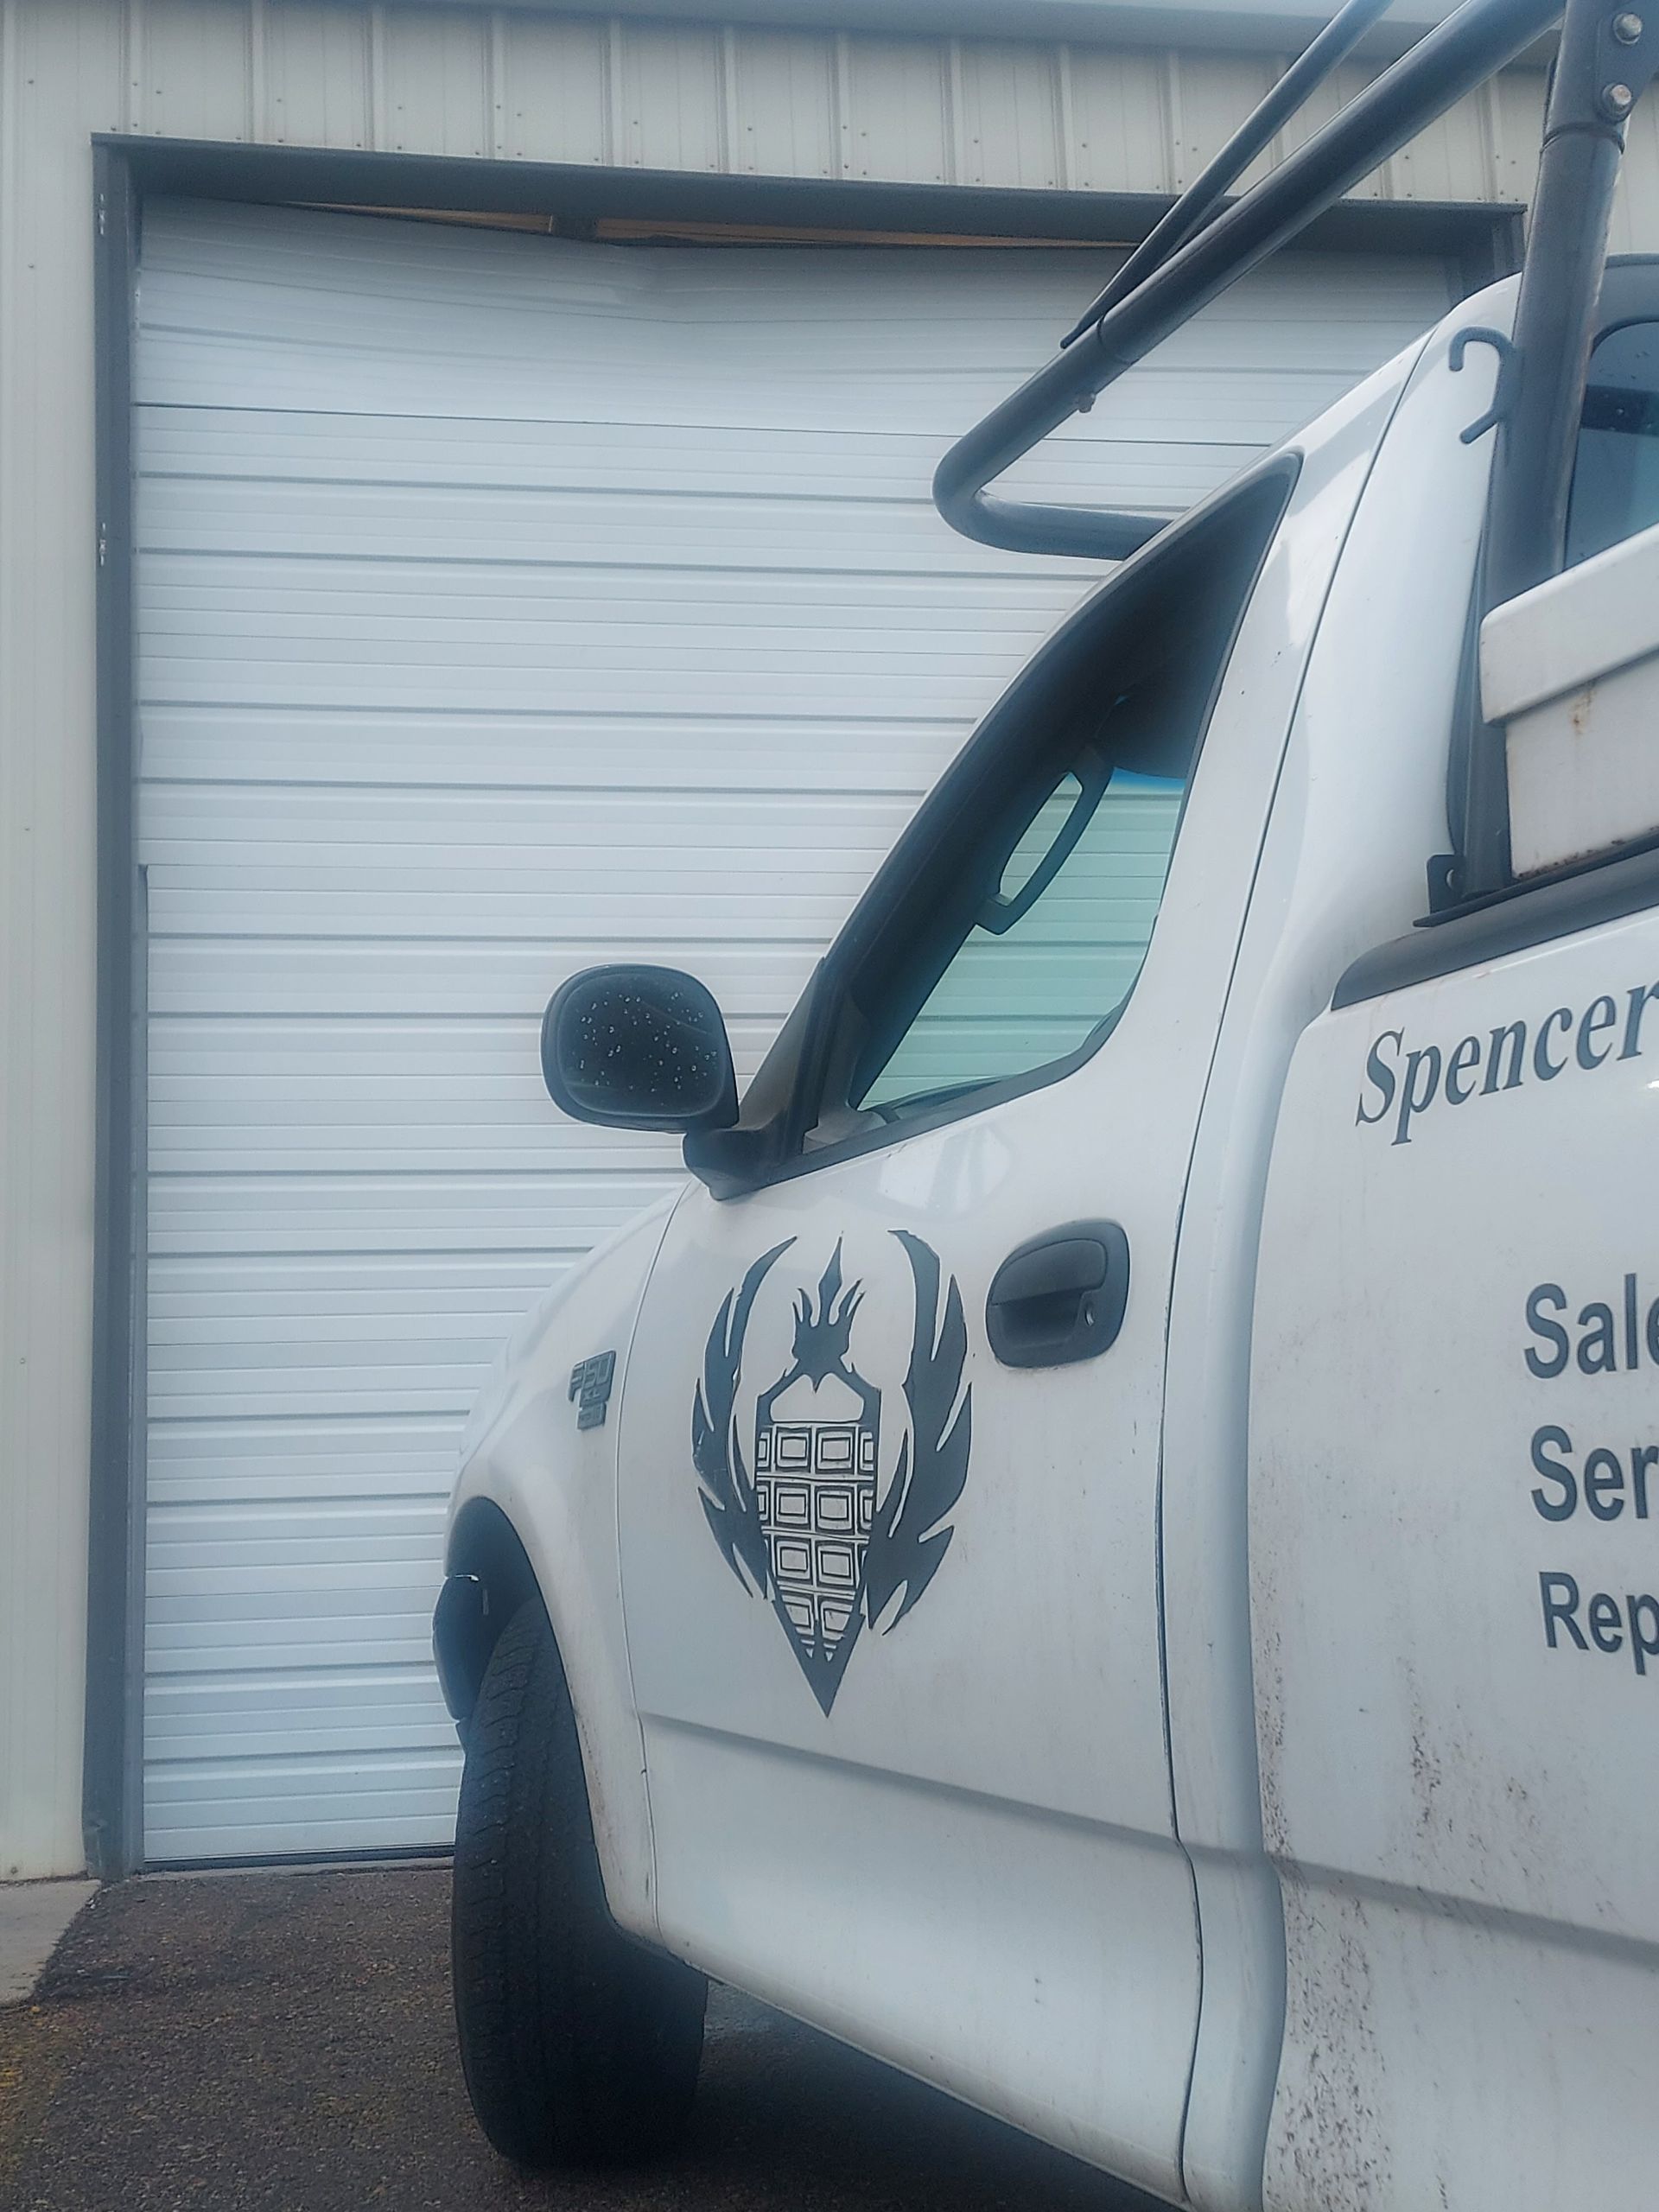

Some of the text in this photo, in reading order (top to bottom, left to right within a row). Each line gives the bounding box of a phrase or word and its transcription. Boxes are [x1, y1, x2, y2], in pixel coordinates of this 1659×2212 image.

[1355, 980, 1659, 1147] Spencer
[1530, 1424, 1659, 1522] Ser
[1538, 1570, 1659, 1676] Rep
